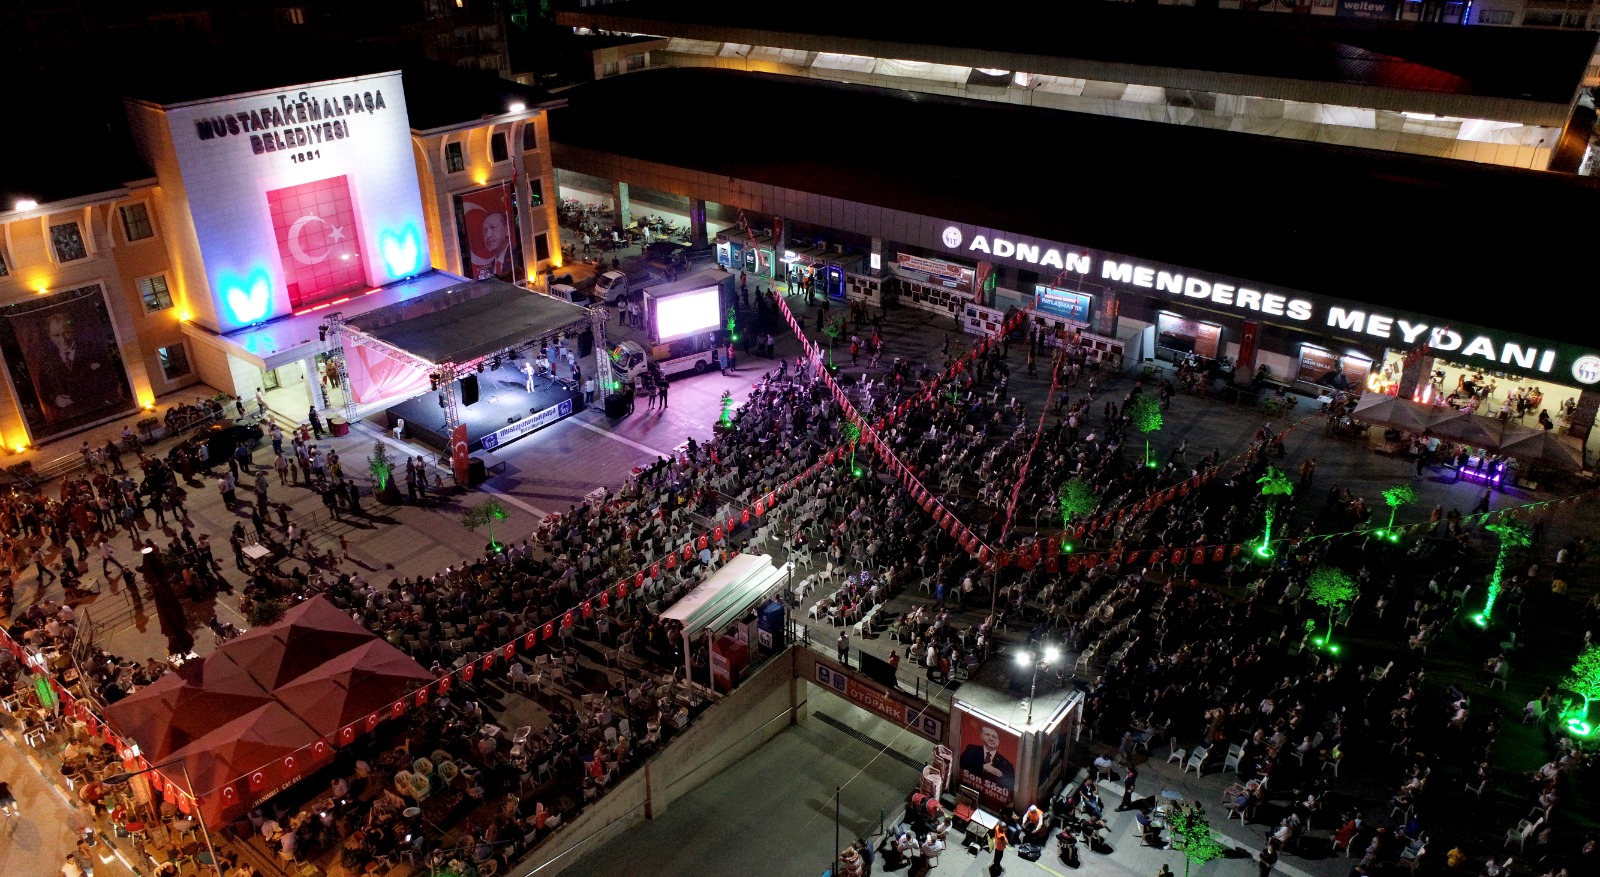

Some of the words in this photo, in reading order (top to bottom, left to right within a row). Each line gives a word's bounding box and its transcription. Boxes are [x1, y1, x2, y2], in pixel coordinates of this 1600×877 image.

[1344, 1, 1385, 12] weltew
[194, 89, 387, 141] MUSTAFAKEMALPAŞA
[250, 120, 350, 155] BELEDİYESİ
[291, 149, 321, 164] 1881
[968, 235, 1091, 275] ADNAN
[1101, 259, 1313, 322] MENDERES
[1326, 306, 1557, 374] MEYDANI
[850, 688, 901, 720] OTOPARK
[963, 769, 982, 784] Son
[984, 779, 1009, 797] Sözü
